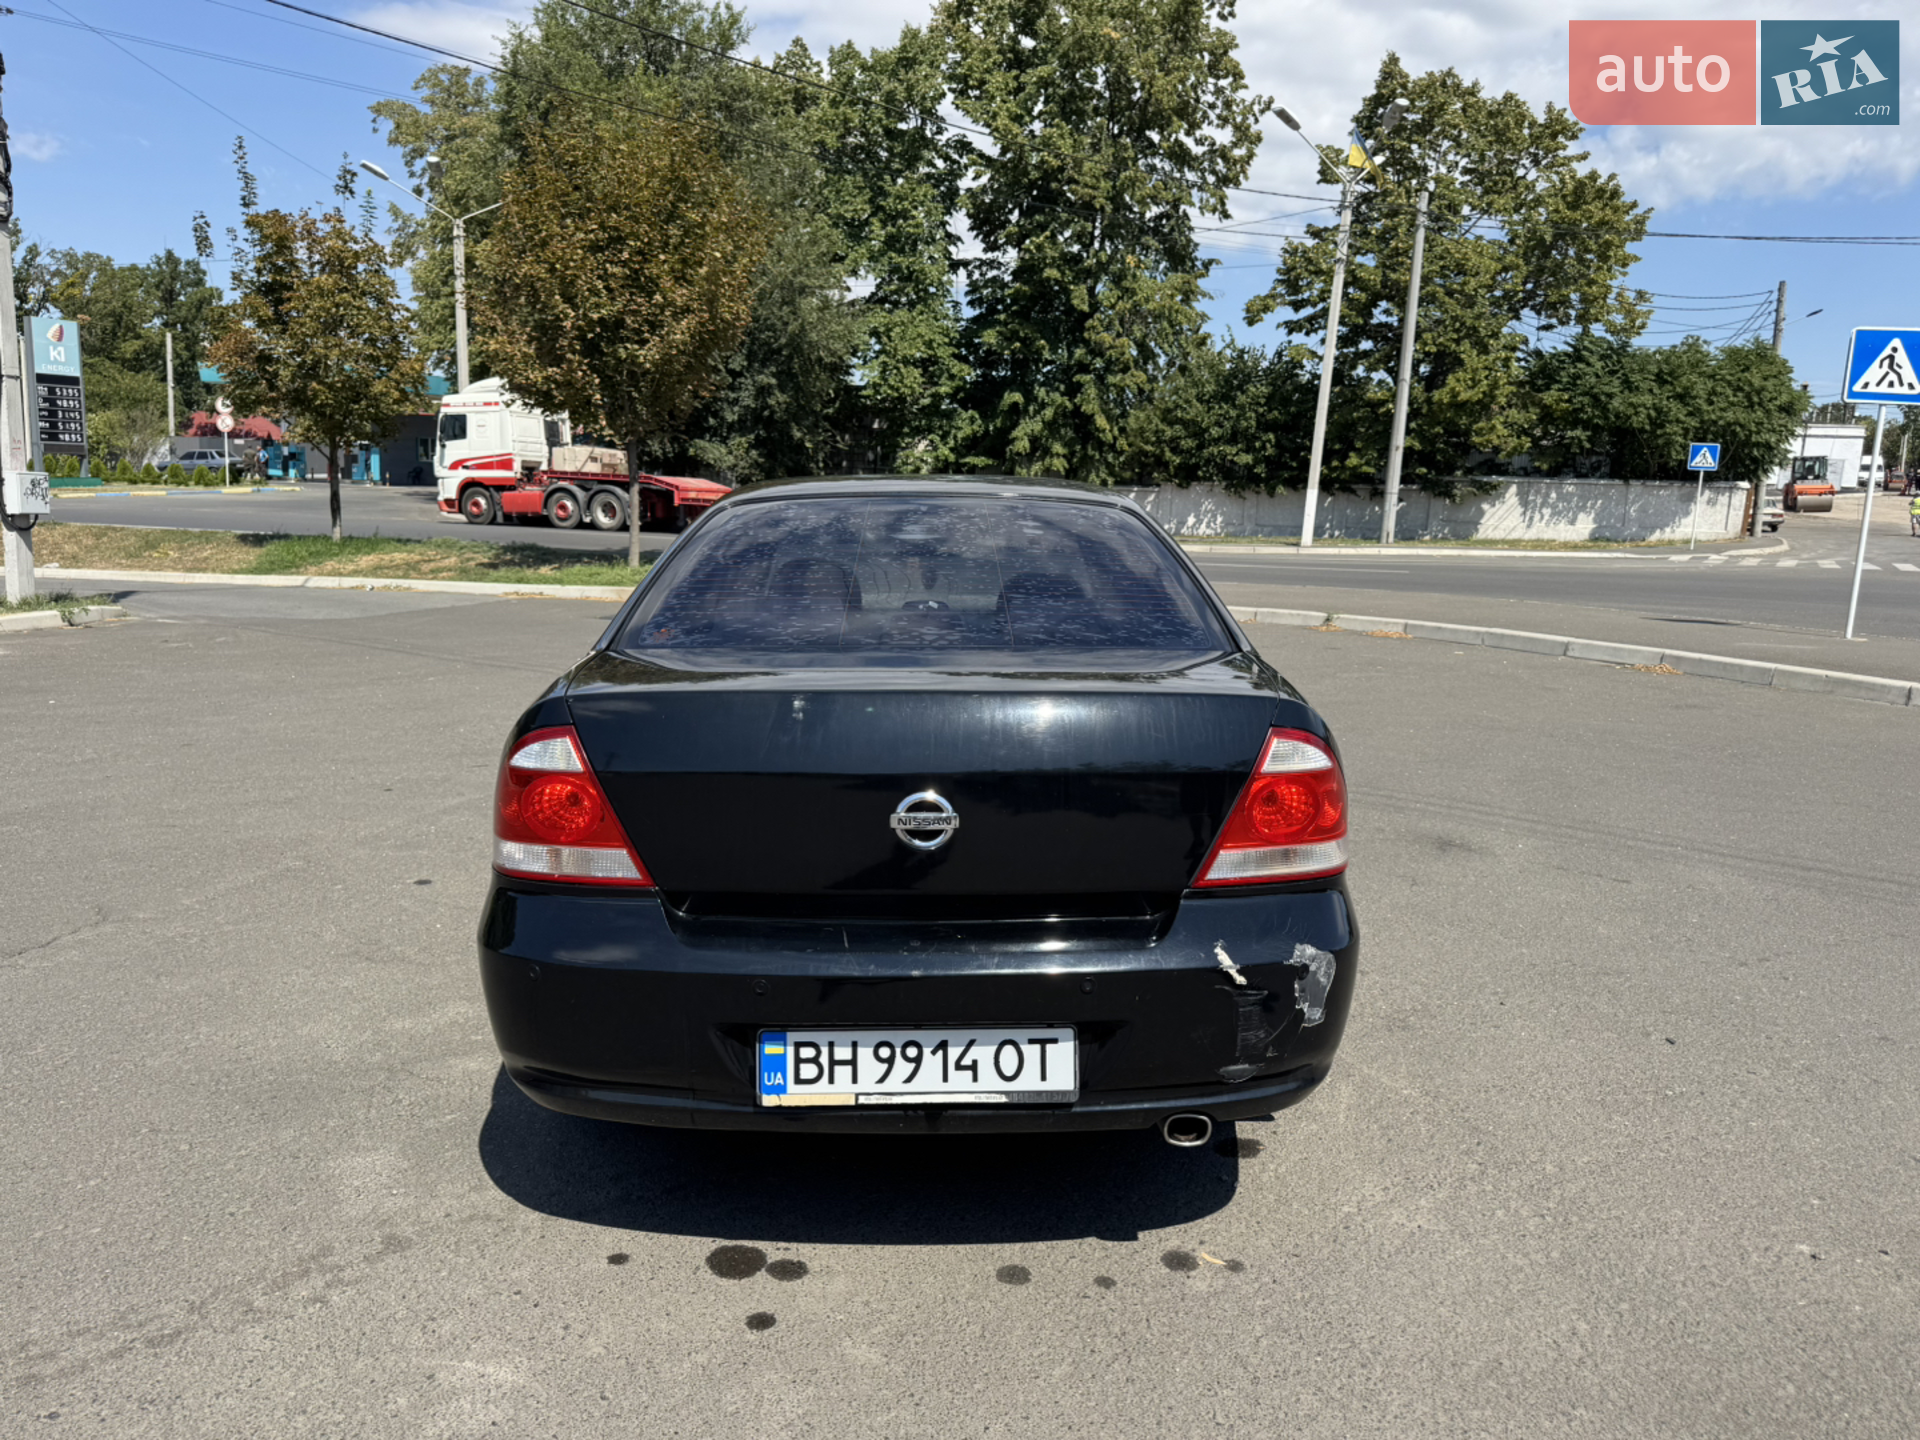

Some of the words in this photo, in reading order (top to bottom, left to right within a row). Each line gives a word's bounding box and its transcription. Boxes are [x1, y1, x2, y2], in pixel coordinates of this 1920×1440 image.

[42, 364, 75, 373] ENERGY
[897, 818, 951, 826] NISSAN
[793, 1041, 858, 1085] BH
[873, 1038, 979, 1085] 9914
[993, 1038, 1059, 1082] OT
[764, 1071, 785, 1086] UA
